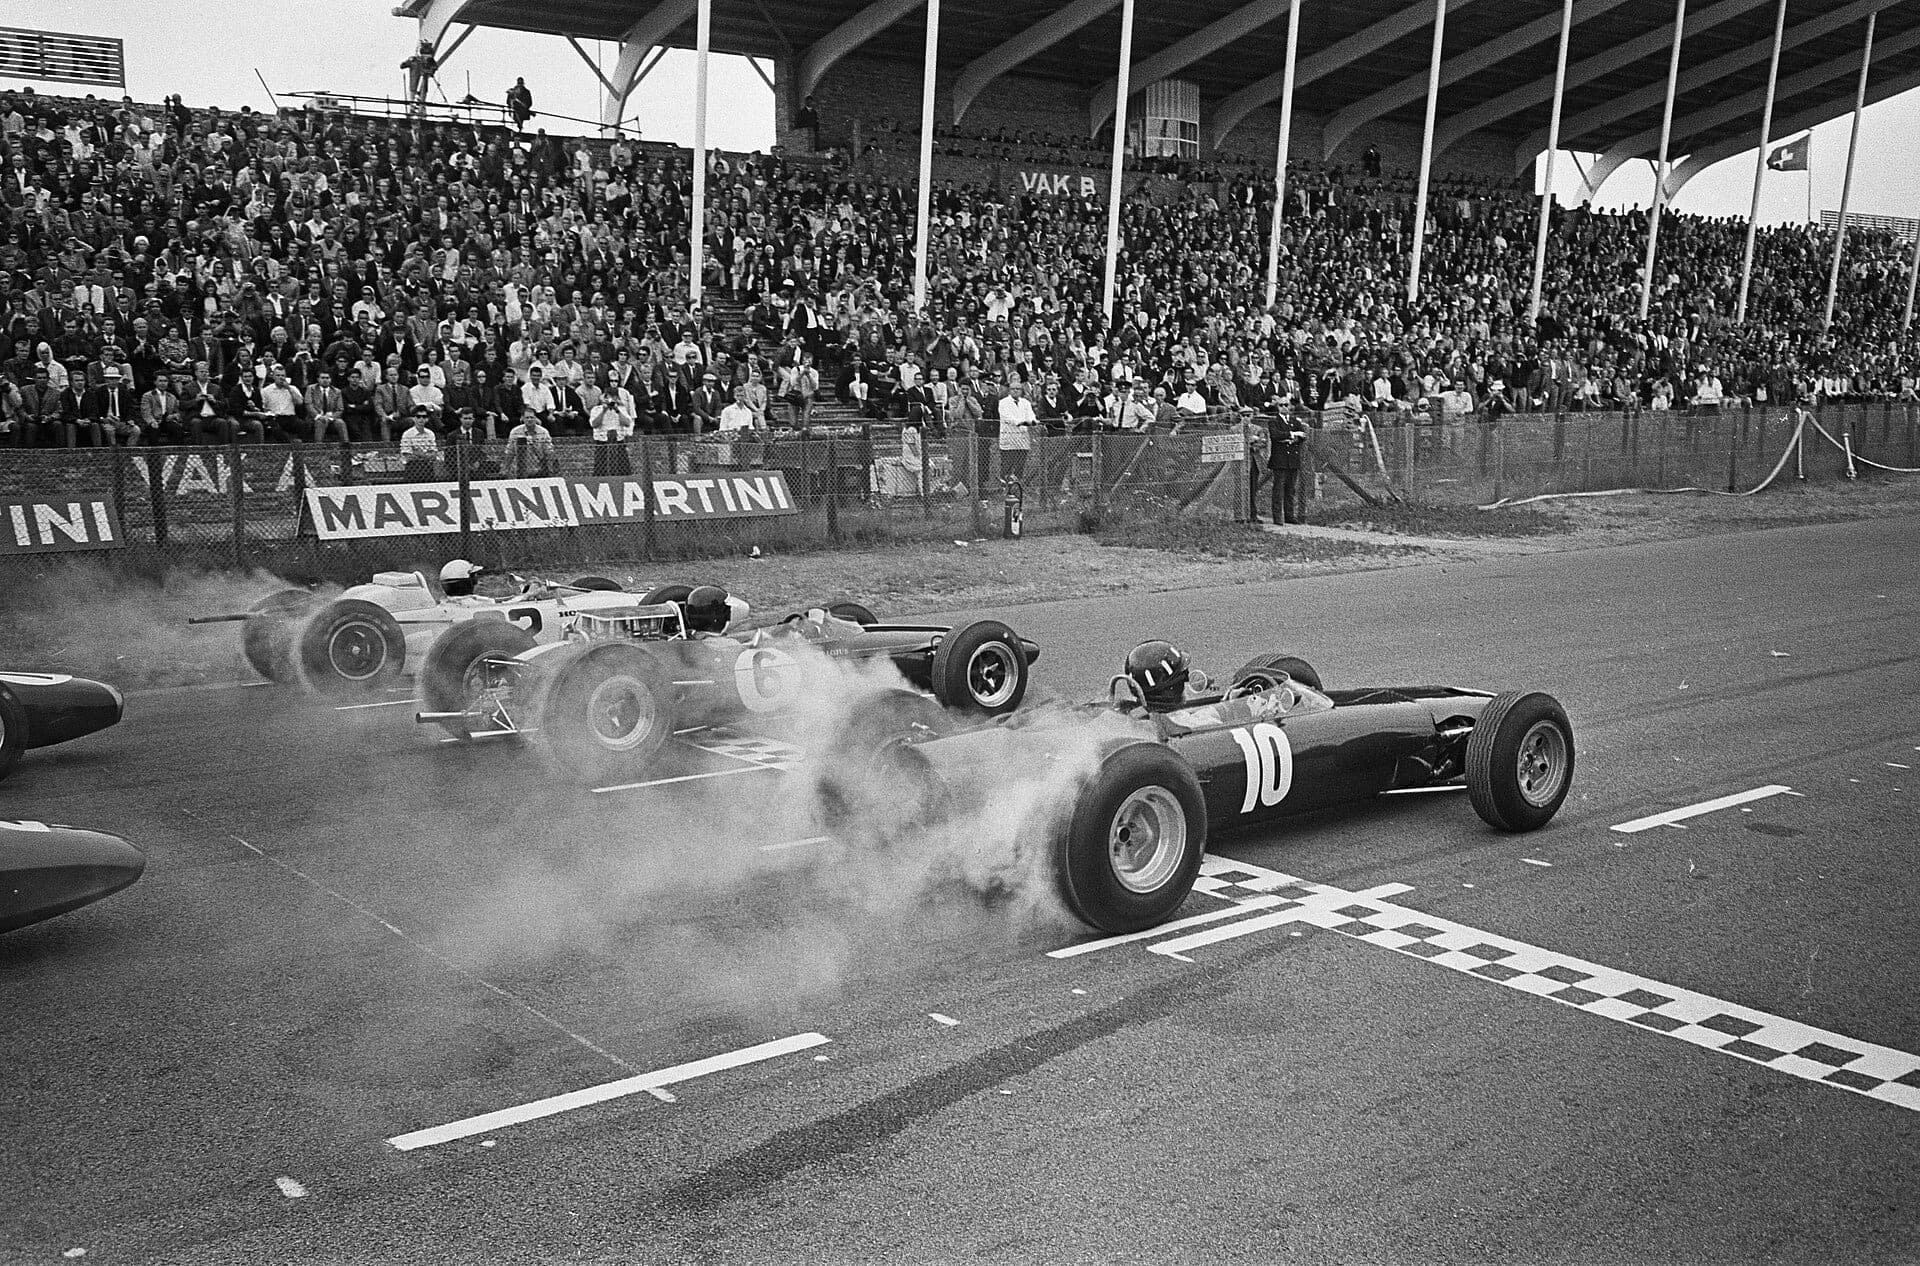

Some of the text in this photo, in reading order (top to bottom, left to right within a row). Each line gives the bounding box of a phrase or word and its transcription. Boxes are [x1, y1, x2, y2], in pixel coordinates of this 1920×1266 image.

[0, 34, 113, 81] EN
[1020, 171, 1096, 198] VAK B
[318, 485, 569, 532] MARTINI
[574, 476, 789, 519] MARTINI
[0, 501, 114, 546] INI
[752, 650, 783, 700] 6
[1229, 723, 1293, 814] 10
